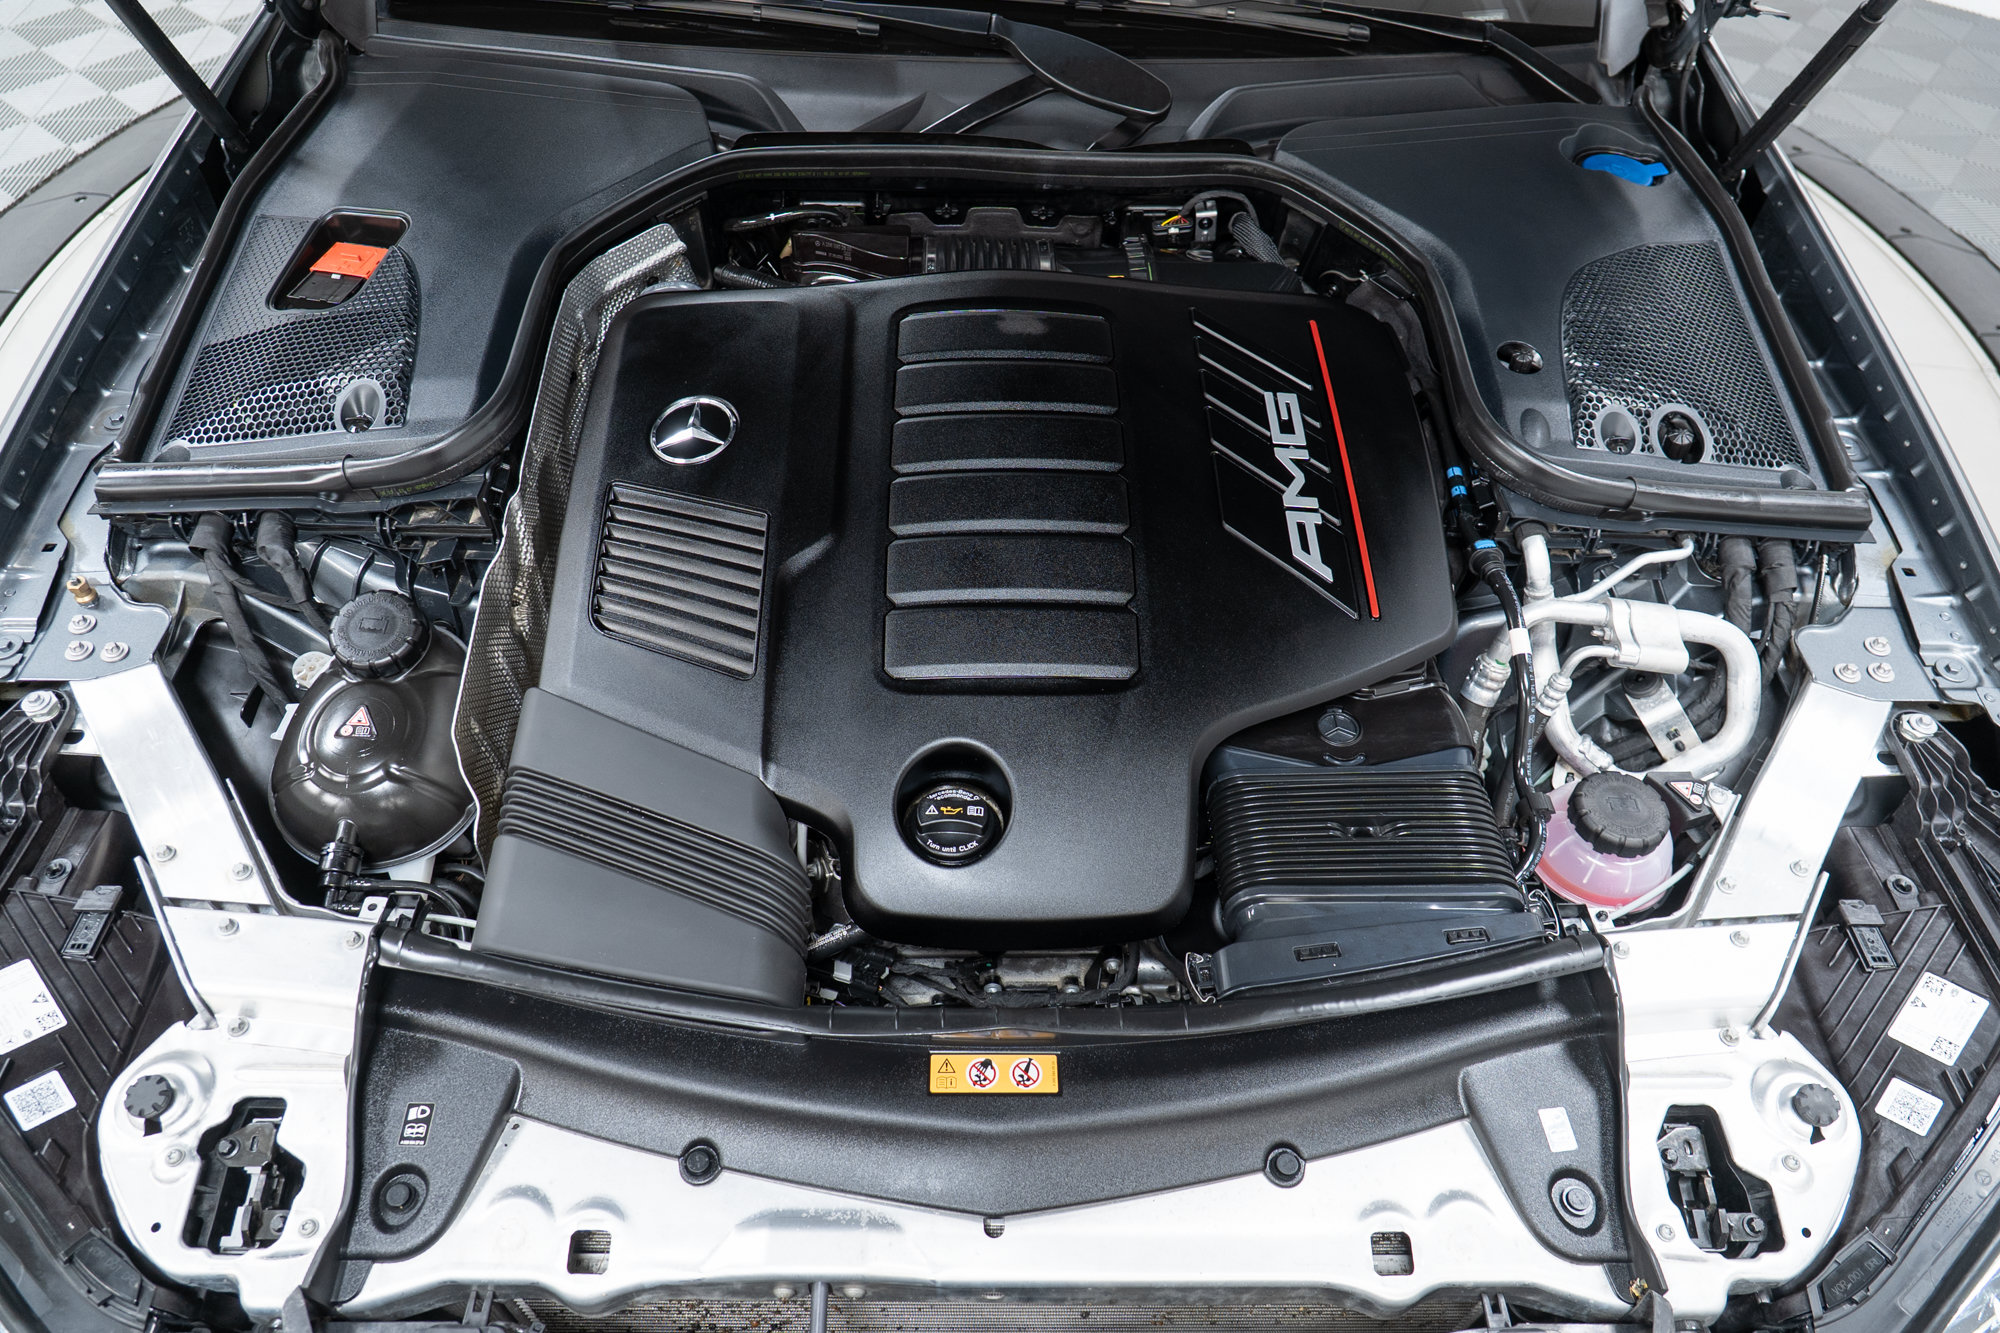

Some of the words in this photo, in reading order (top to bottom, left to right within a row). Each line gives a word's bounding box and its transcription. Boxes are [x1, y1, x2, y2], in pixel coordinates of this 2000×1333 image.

[1264, 391, 1333, 583] AMG
[926, 838, 940, 850] Turn
[958, 840, 979, 852] CLICK
